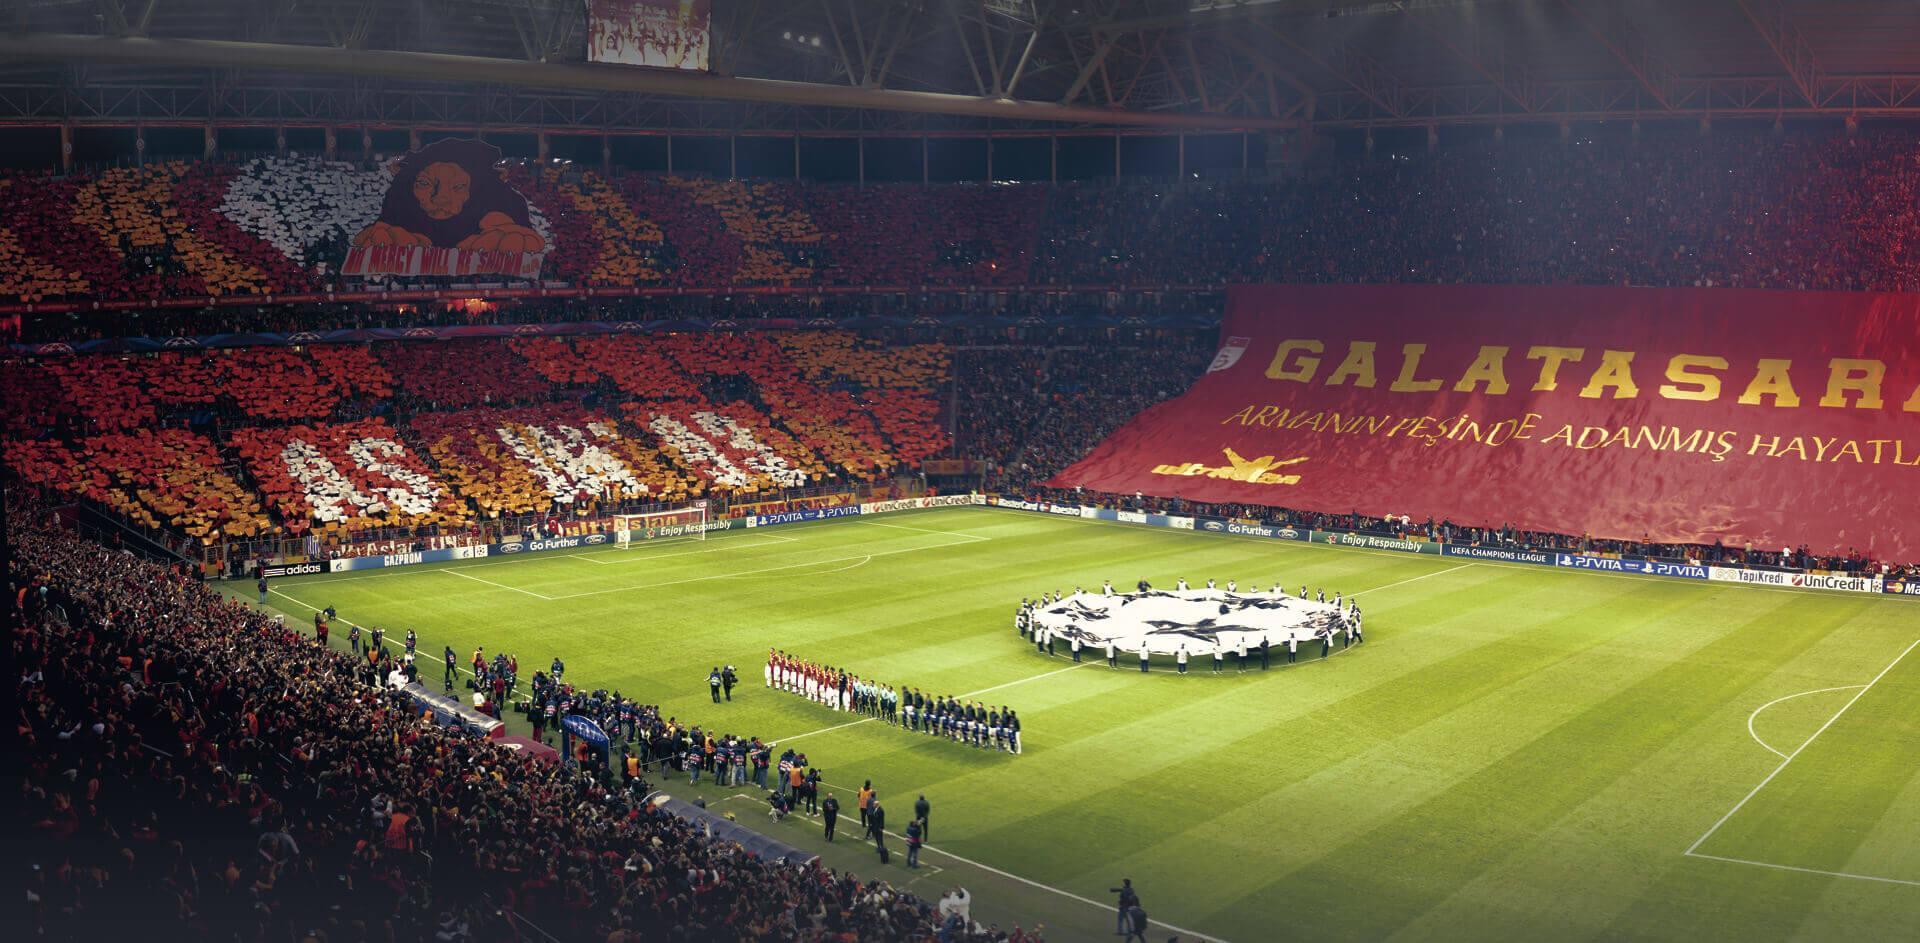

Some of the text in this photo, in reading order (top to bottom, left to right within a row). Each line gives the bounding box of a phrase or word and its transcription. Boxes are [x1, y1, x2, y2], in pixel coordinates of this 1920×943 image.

[368, 246, 414, 274] MERCY
[420, 246, 450, 274] WILL
[1221, 405, 1920, 467] ARMANIN PEŞİNDE ADANMIŞ HAYATL
[880, 499, 917, 512] UniCredit
[931, 495, 973, 506] UniCredit
[660, 519, 732, 537] Enjoy Responsibly
[1228, 524, 1240, 533] Go
[1241, 525, 1272, 537] Further
[529, 541, 544, 551] Go
[545, 538, 579, 550] Further
[1341, 534, 1422, 552] Enjoy Responsibly
[384, 551, 423, 567] GAZPROM
[1451, 547, 1546, 562] UEFA CHAMPIONS LEAGUE
[286, 564, 321, 576] adidas
[1804, 575, 1865, 591] UniCredit
